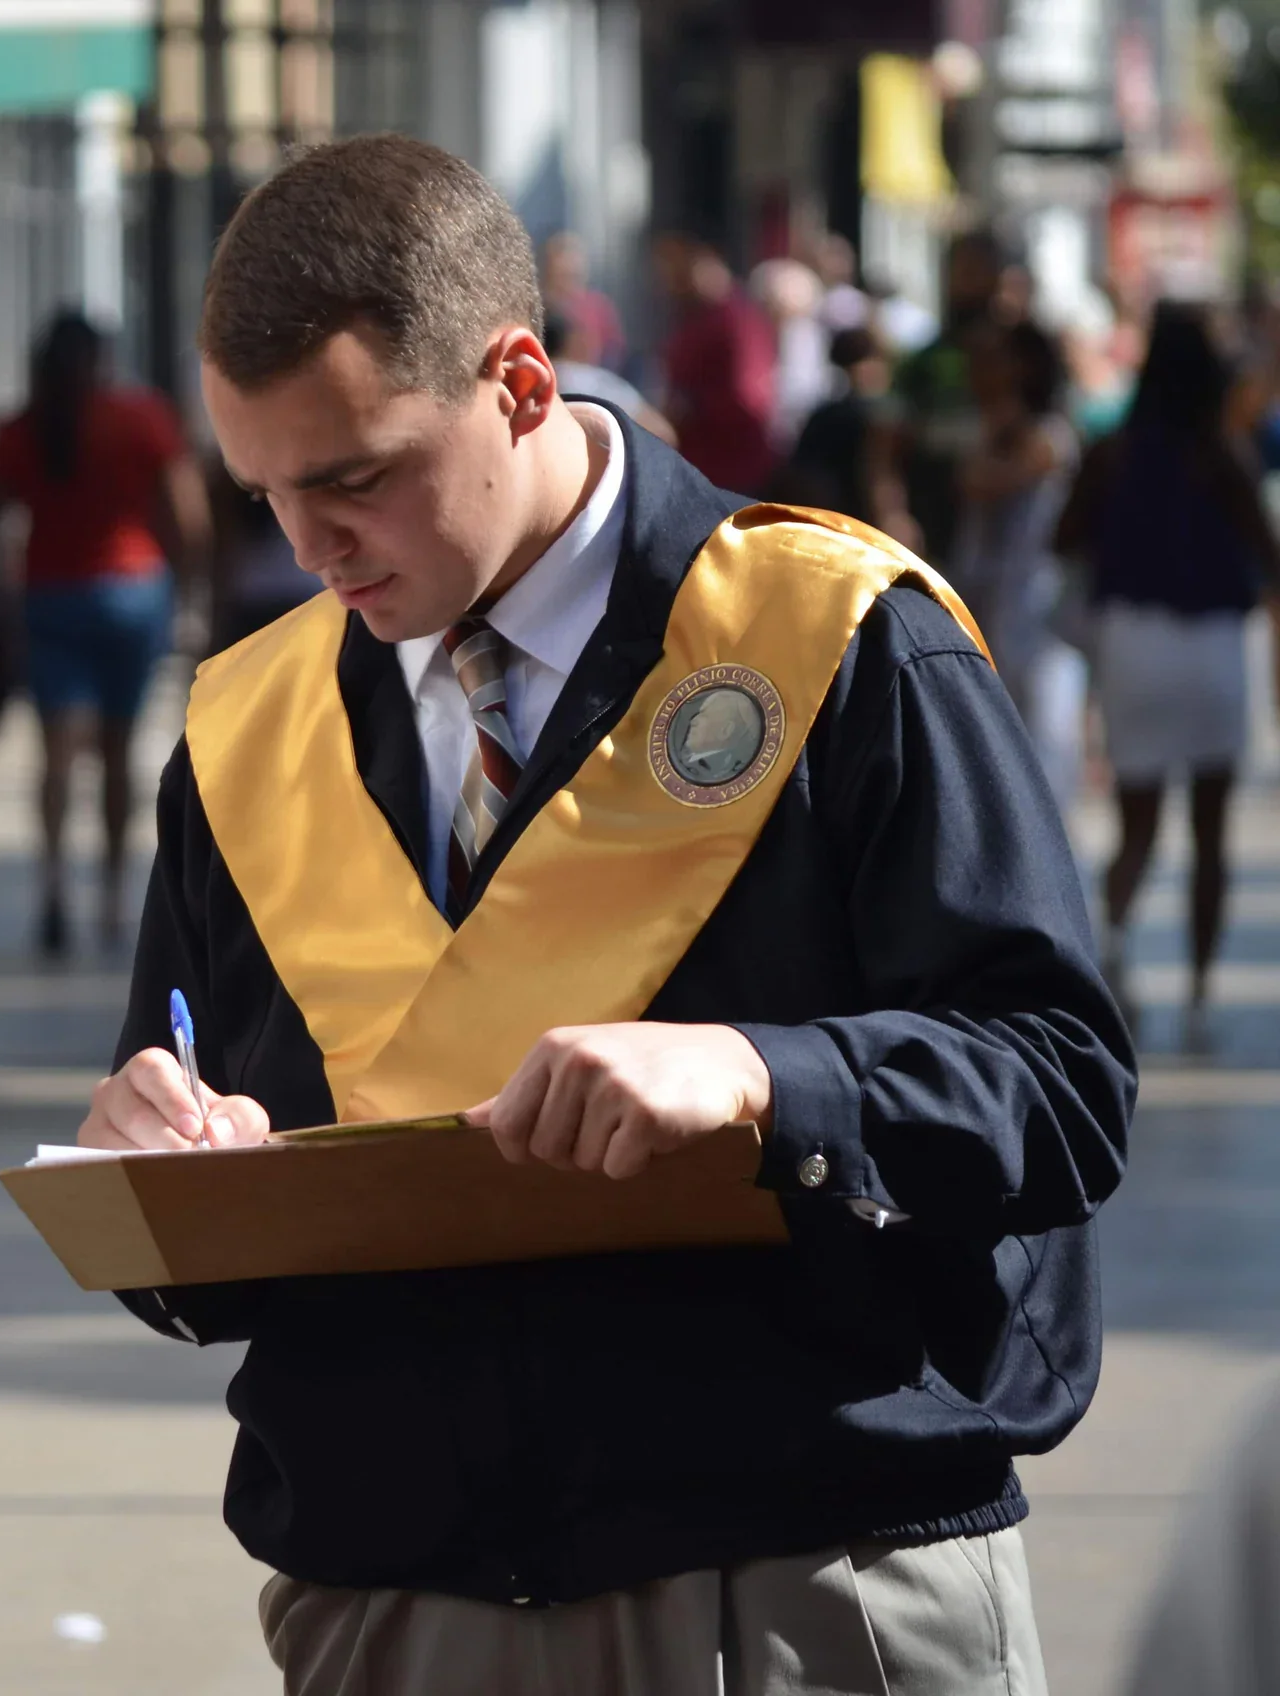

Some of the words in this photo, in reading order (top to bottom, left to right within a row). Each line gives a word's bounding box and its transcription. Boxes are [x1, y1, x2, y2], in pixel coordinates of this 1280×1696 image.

[676, 668, 727, 699] PLINIO
[732, 668, 776, 711] CORREA
[652, 700, 675, 781] INSTITUTO
[769, 715, 781, 736] DE
[720, 741, 776, 800] OLIVEIRA
